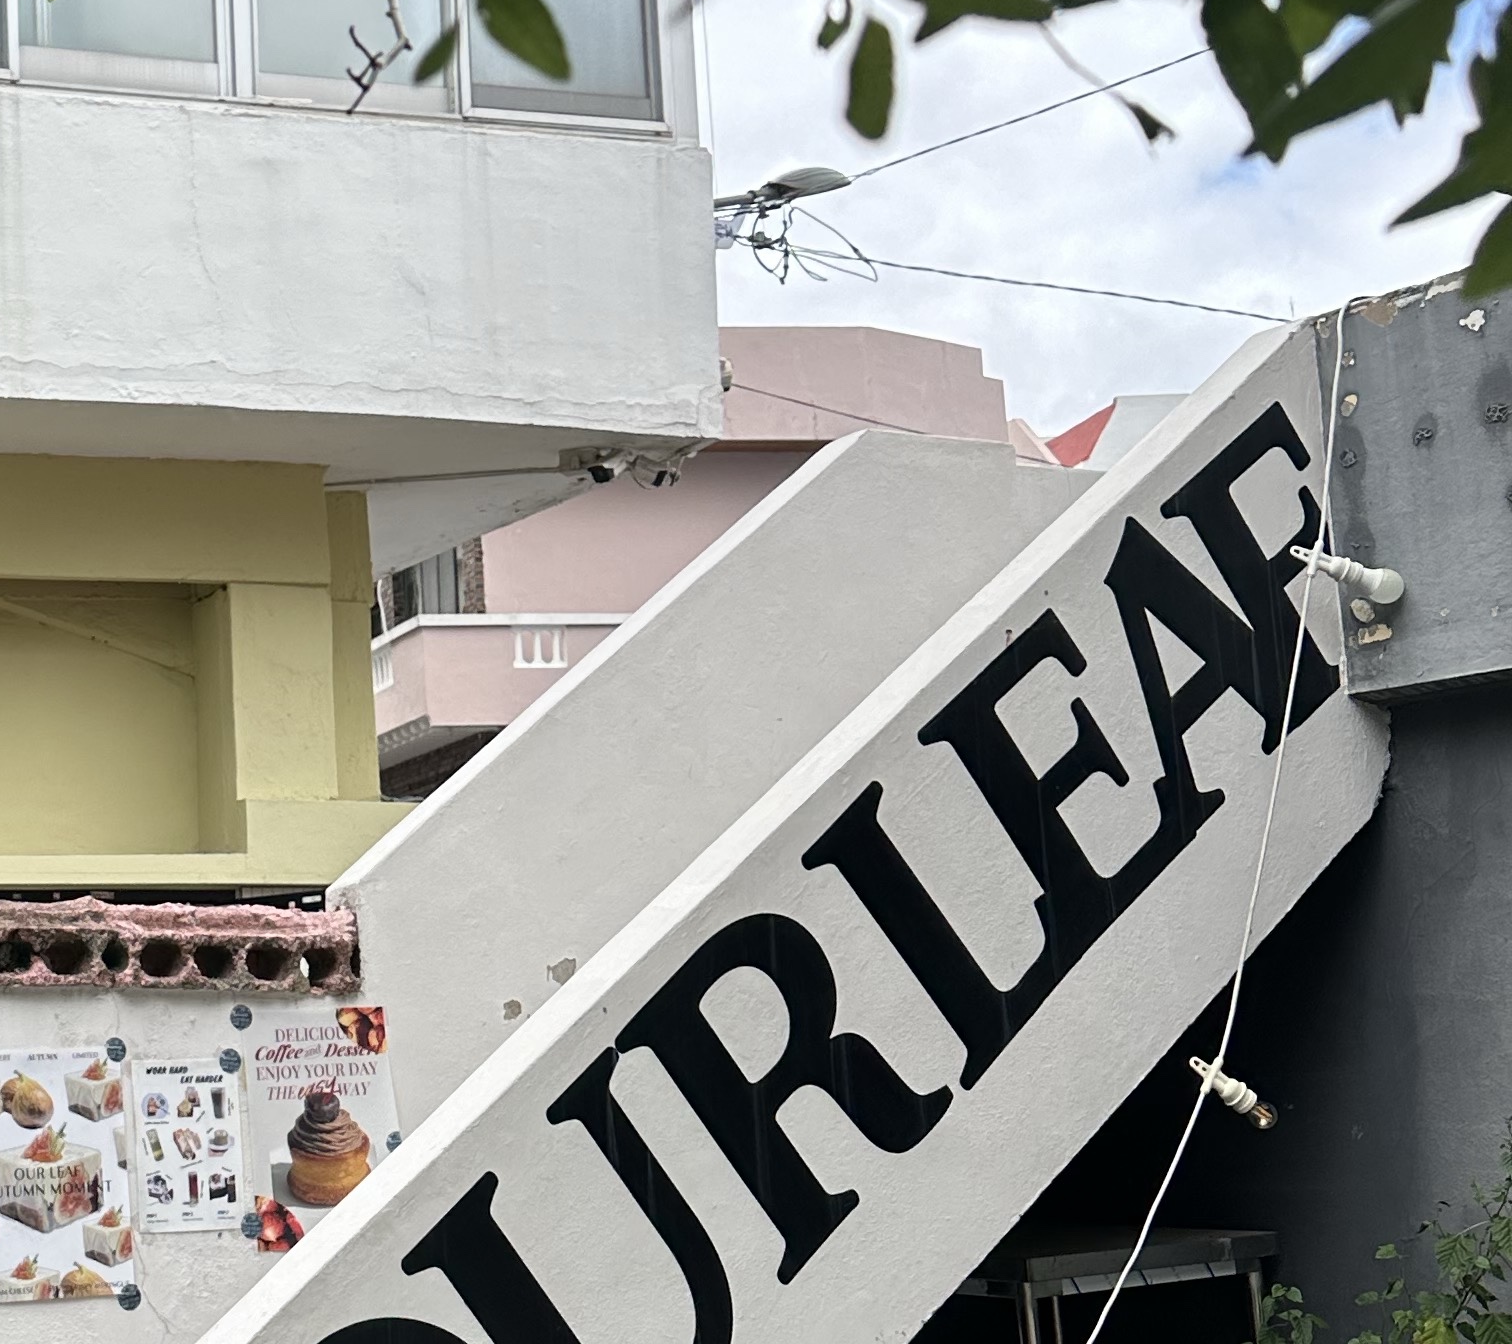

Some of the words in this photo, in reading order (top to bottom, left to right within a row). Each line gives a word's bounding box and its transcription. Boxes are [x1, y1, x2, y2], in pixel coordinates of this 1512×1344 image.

[275, 1026, 345, 1043] DELICIOU
[255, 1044, 304, 1063] Coffee
[256, 1064, 300, 1082] ENJOY
[304, 1062, 346, 1079] YOUR
[349, 1060, 378, 1075] DAY
[267, 1085, 296, 1101] THE
[338, 1081, 371, 1096] WAY
[14, 1167, 45, 1181] OUR
[50, 1165, 81, 1179] LEAF
